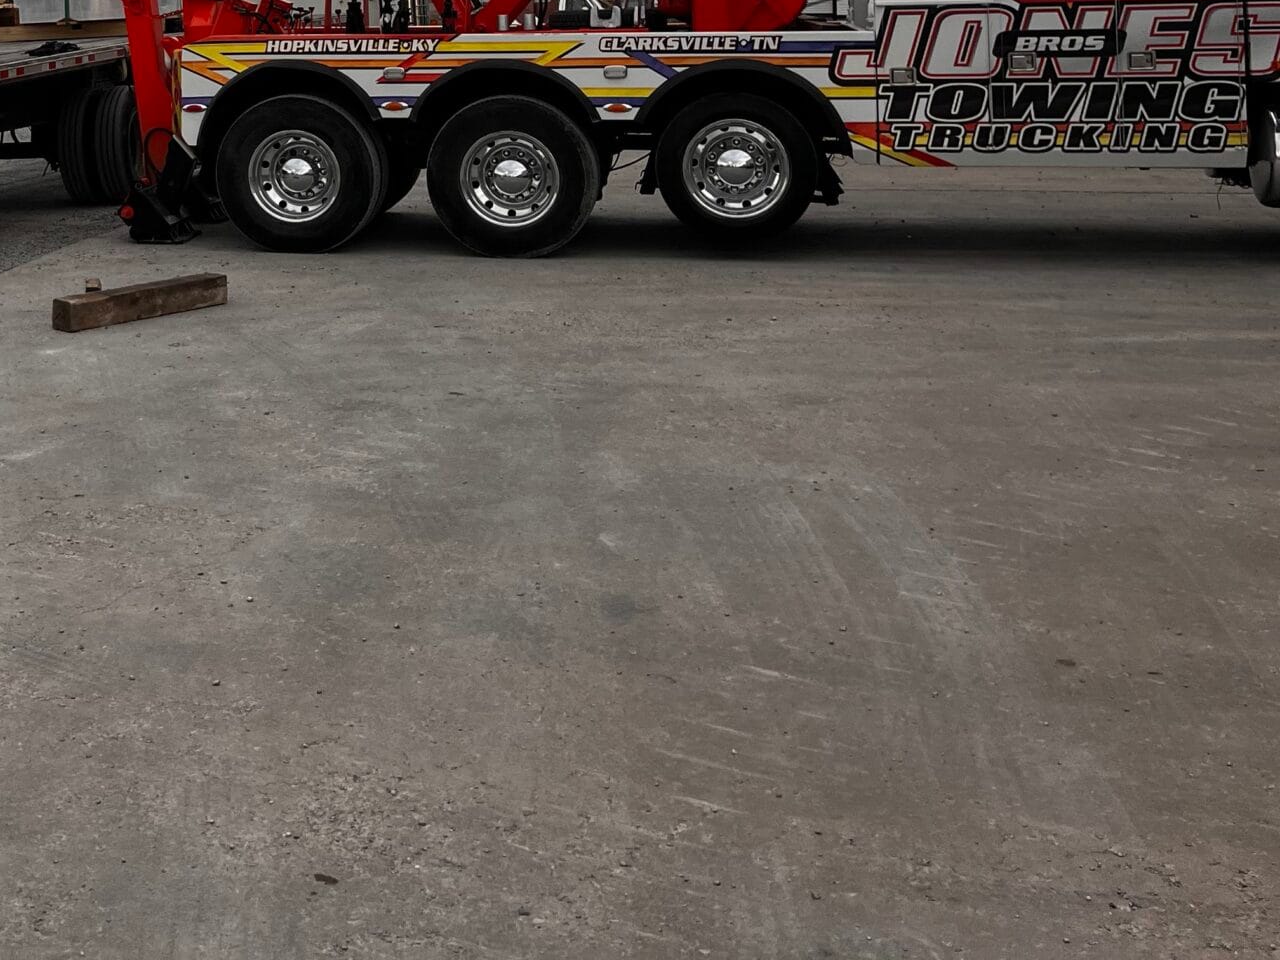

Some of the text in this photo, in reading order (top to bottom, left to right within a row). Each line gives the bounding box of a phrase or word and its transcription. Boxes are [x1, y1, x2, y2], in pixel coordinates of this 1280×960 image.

[834, 1, 1280, 79] JONES
[1014, 34, 1107, 53] BROS
[878, 81, 1245, 123] TOWING
[890, 123, 1230, 153] TRUCKING
